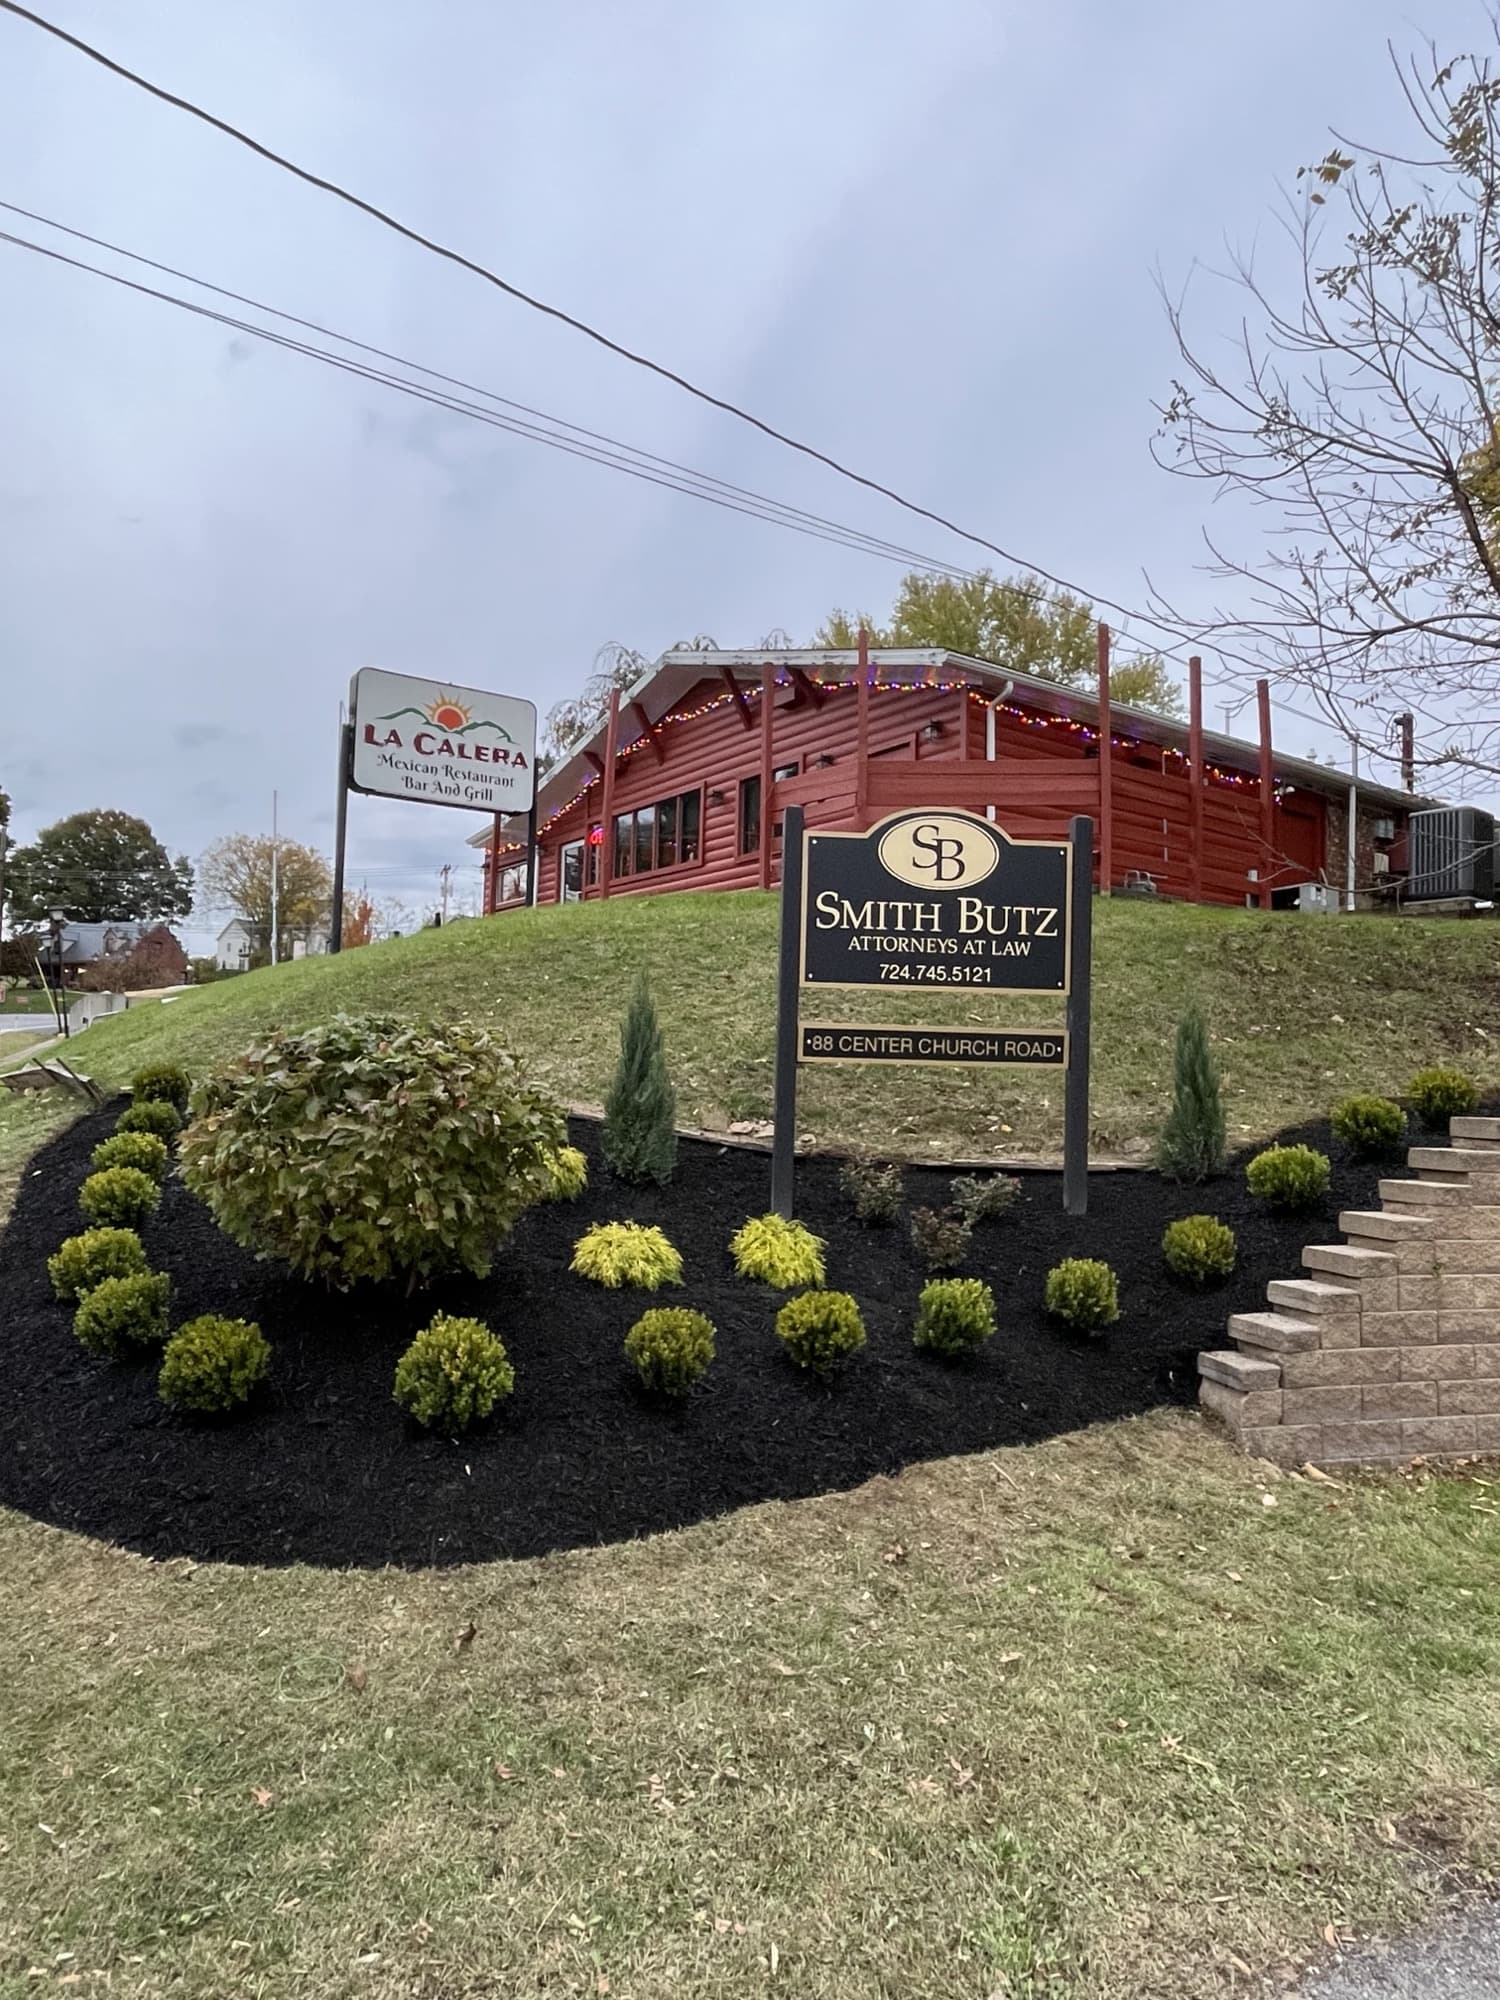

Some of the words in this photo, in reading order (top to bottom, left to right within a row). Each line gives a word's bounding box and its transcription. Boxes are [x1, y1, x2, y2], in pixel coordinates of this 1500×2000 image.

[364, 723, 403, 748] LA
[413, 732, 528, 770] CALERA
[376, 753, 439, 777] Mexican
[441, 765, 516, 788] Restaurant
[401, 776, 429, 792] Bar
[432, 781, 460, 797] And
[464, 785, 494, 802] Grill
[912, 825, 966, 881] SB
[815, 891, 942, 933] SMITH
[957, 897, 1058, 937] BUTZ
[848, 936, 958, 954] ATTORNEYS
[963, 940, 986, 955] AT
[992, 941, 1032, 957] LAW
[879, 964, 992, 983] 724.745.5121
[812, 1036, 833, 1051] 88
[839, 1036, 913, 1053] CENTER
[918, 1039, 999, 1056] CHURCH
[1004, 1042, 1056, 1058] ROAD
